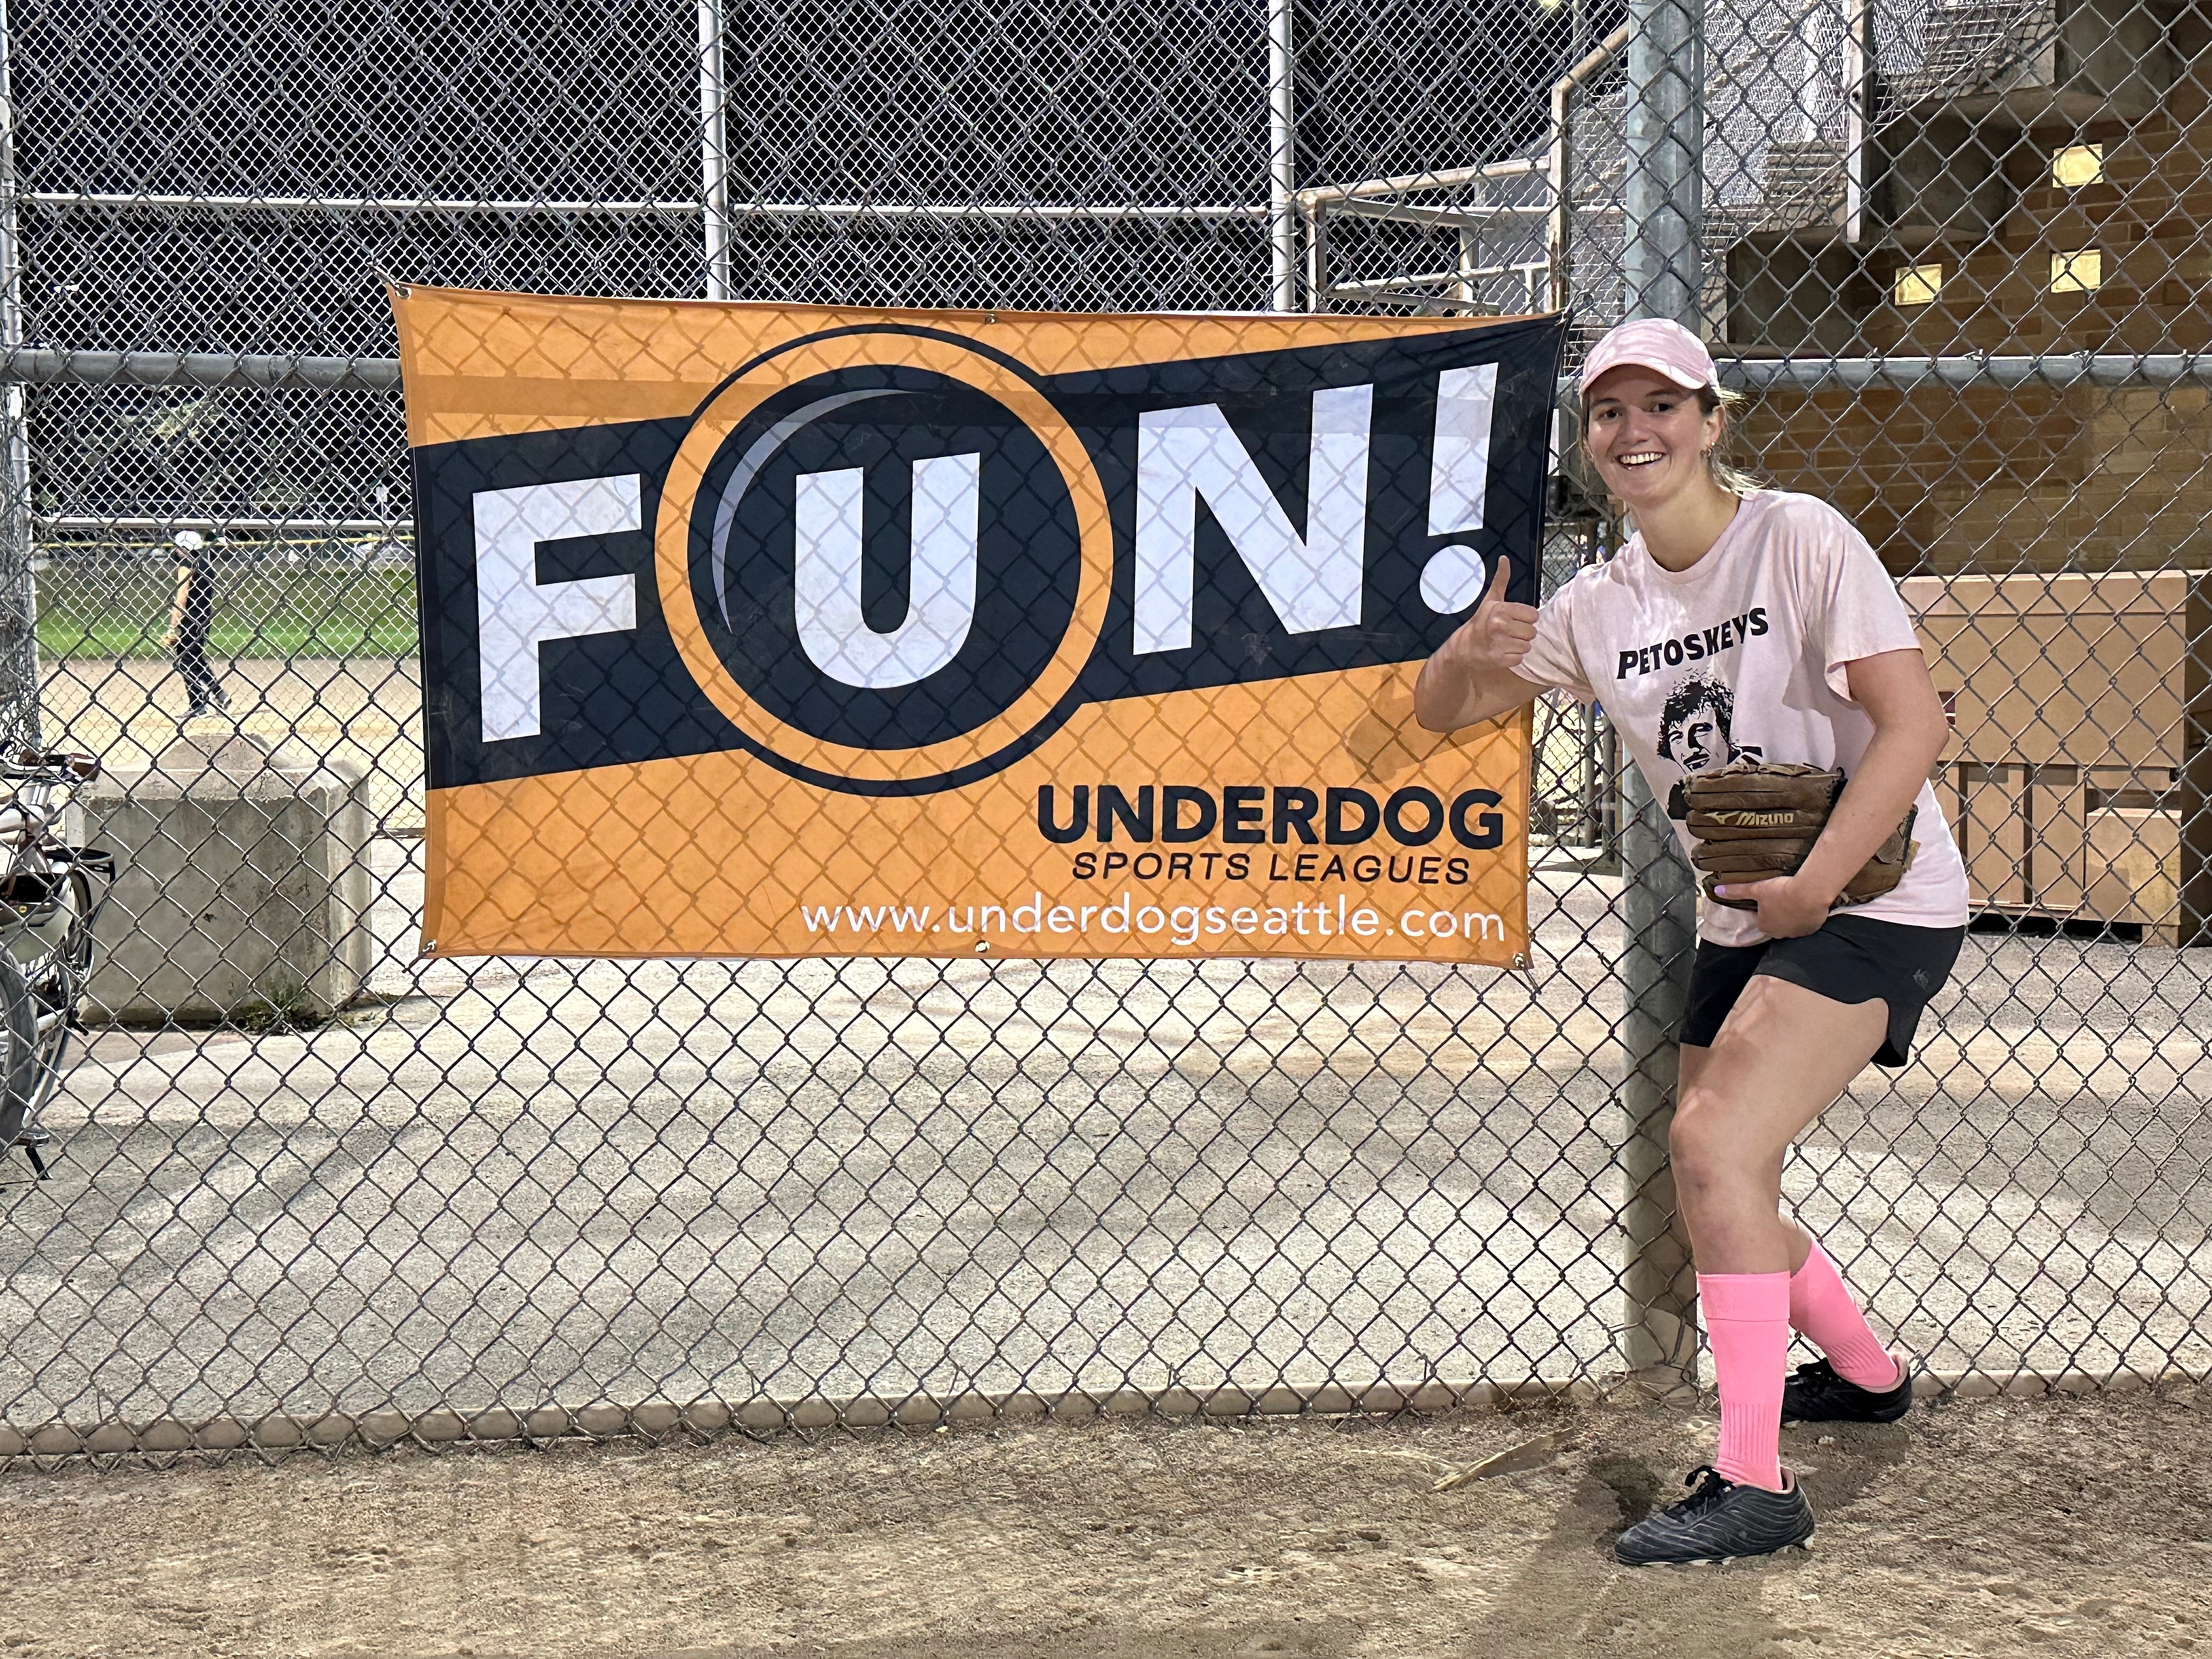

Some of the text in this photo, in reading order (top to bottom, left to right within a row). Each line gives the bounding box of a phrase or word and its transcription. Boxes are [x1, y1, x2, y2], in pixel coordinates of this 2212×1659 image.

[472, 362, 1499, 742] FUN!
[1616, 607, 1769, 679] PETOSKEYS
[1038, 785, 1503, 850] UNDERDOG
[1073, 852, 1470, 885] SPORTS LEAGUES
[800, 891, 1504, 946] www.underdogseattle.com
